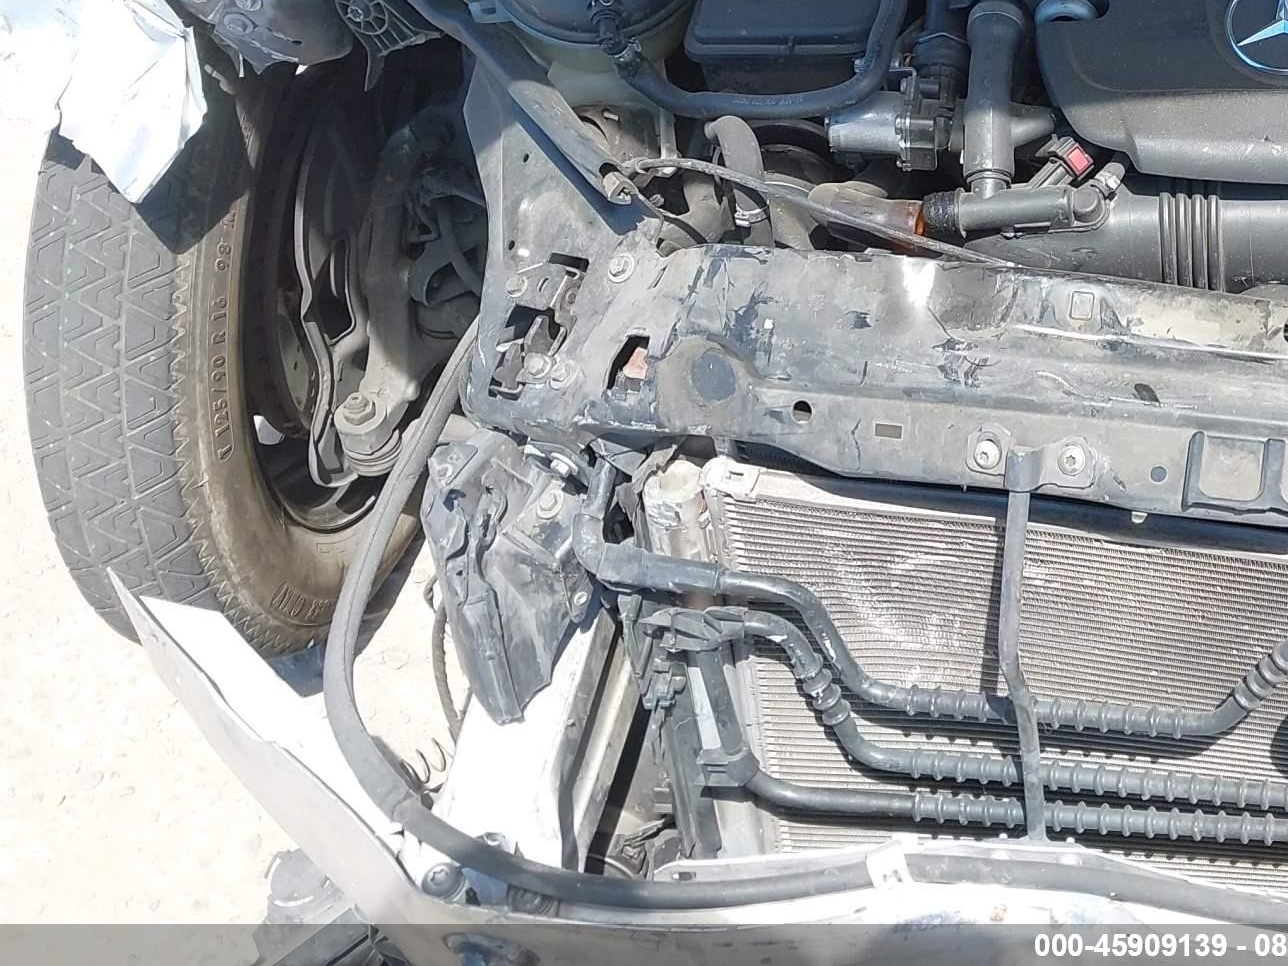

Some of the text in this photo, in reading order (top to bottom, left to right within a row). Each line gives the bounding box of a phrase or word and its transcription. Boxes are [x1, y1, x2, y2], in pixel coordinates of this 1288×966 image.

[215, 242, 232, 272] 98
[210, 295, 227, 322] 16
[210, 330, 227, 346] R
[210, 354, 231, 438] 125/90
